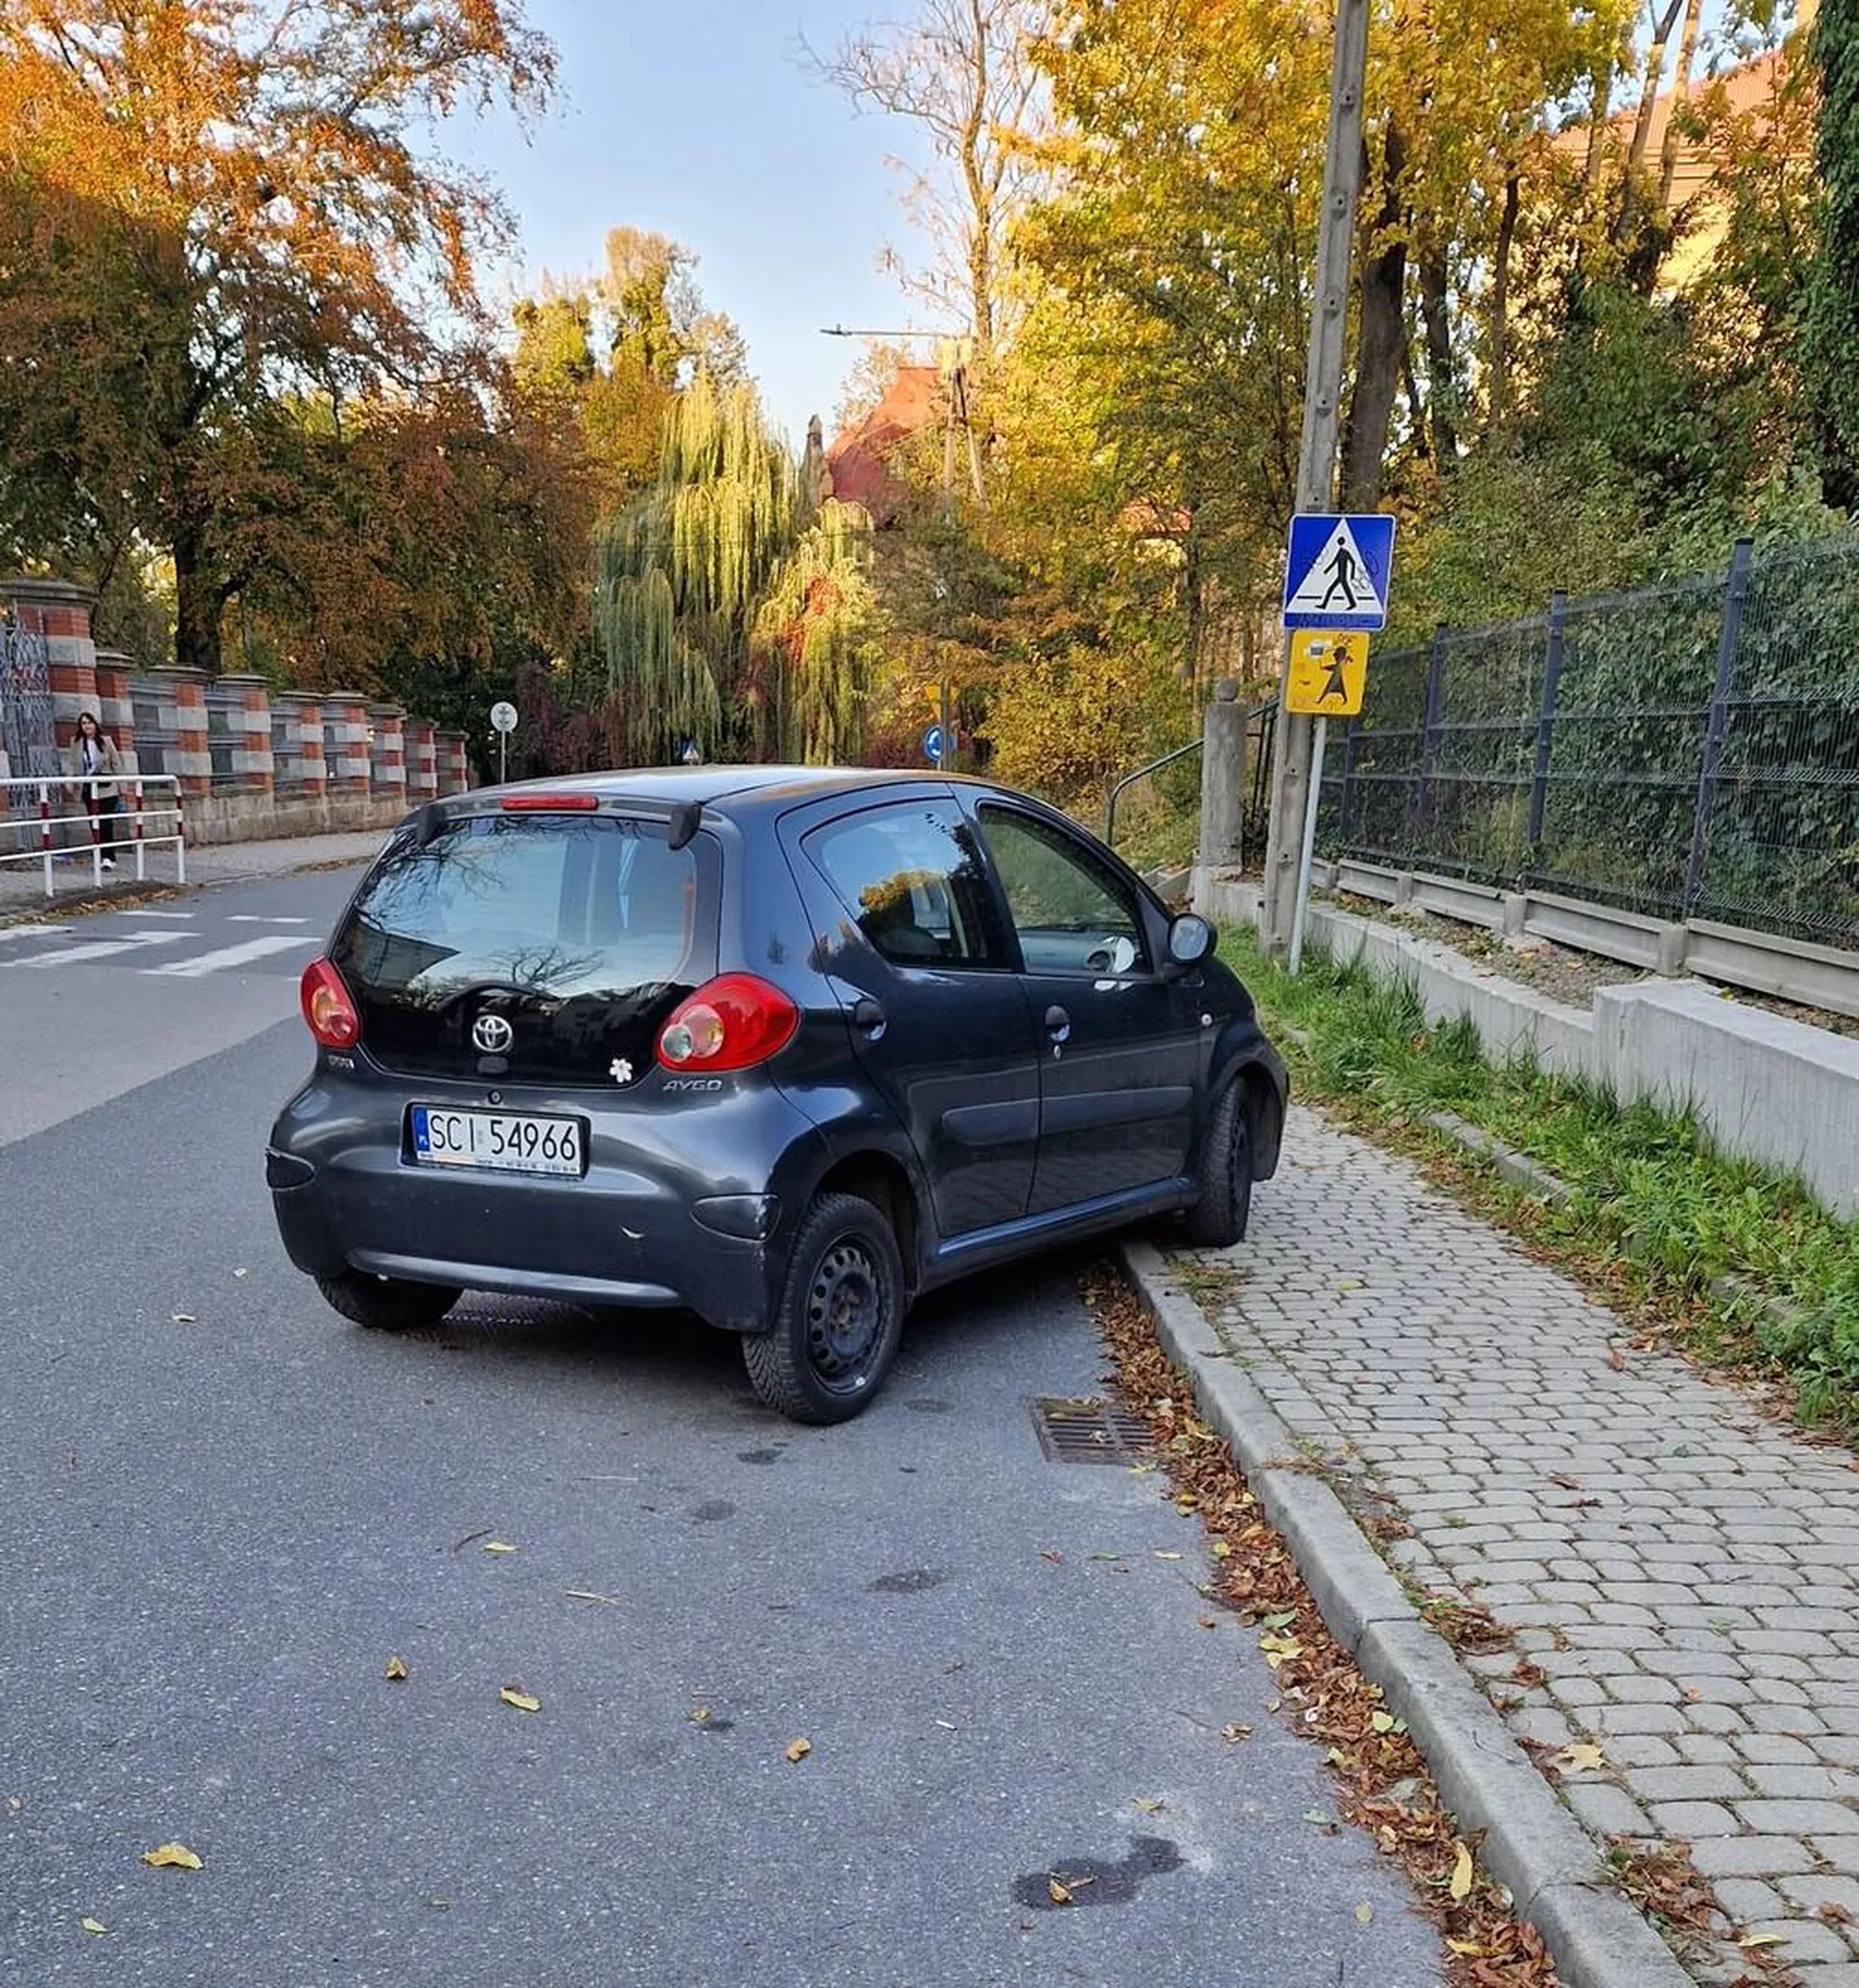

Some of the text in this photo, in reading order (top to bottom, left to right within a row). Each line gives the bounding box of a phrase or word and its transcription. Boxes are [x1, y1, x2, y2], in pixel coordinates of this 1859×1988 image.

[662, 1079, 722, 1091] AYGO
[430, 1115, 576, 1161] SCI 54966
